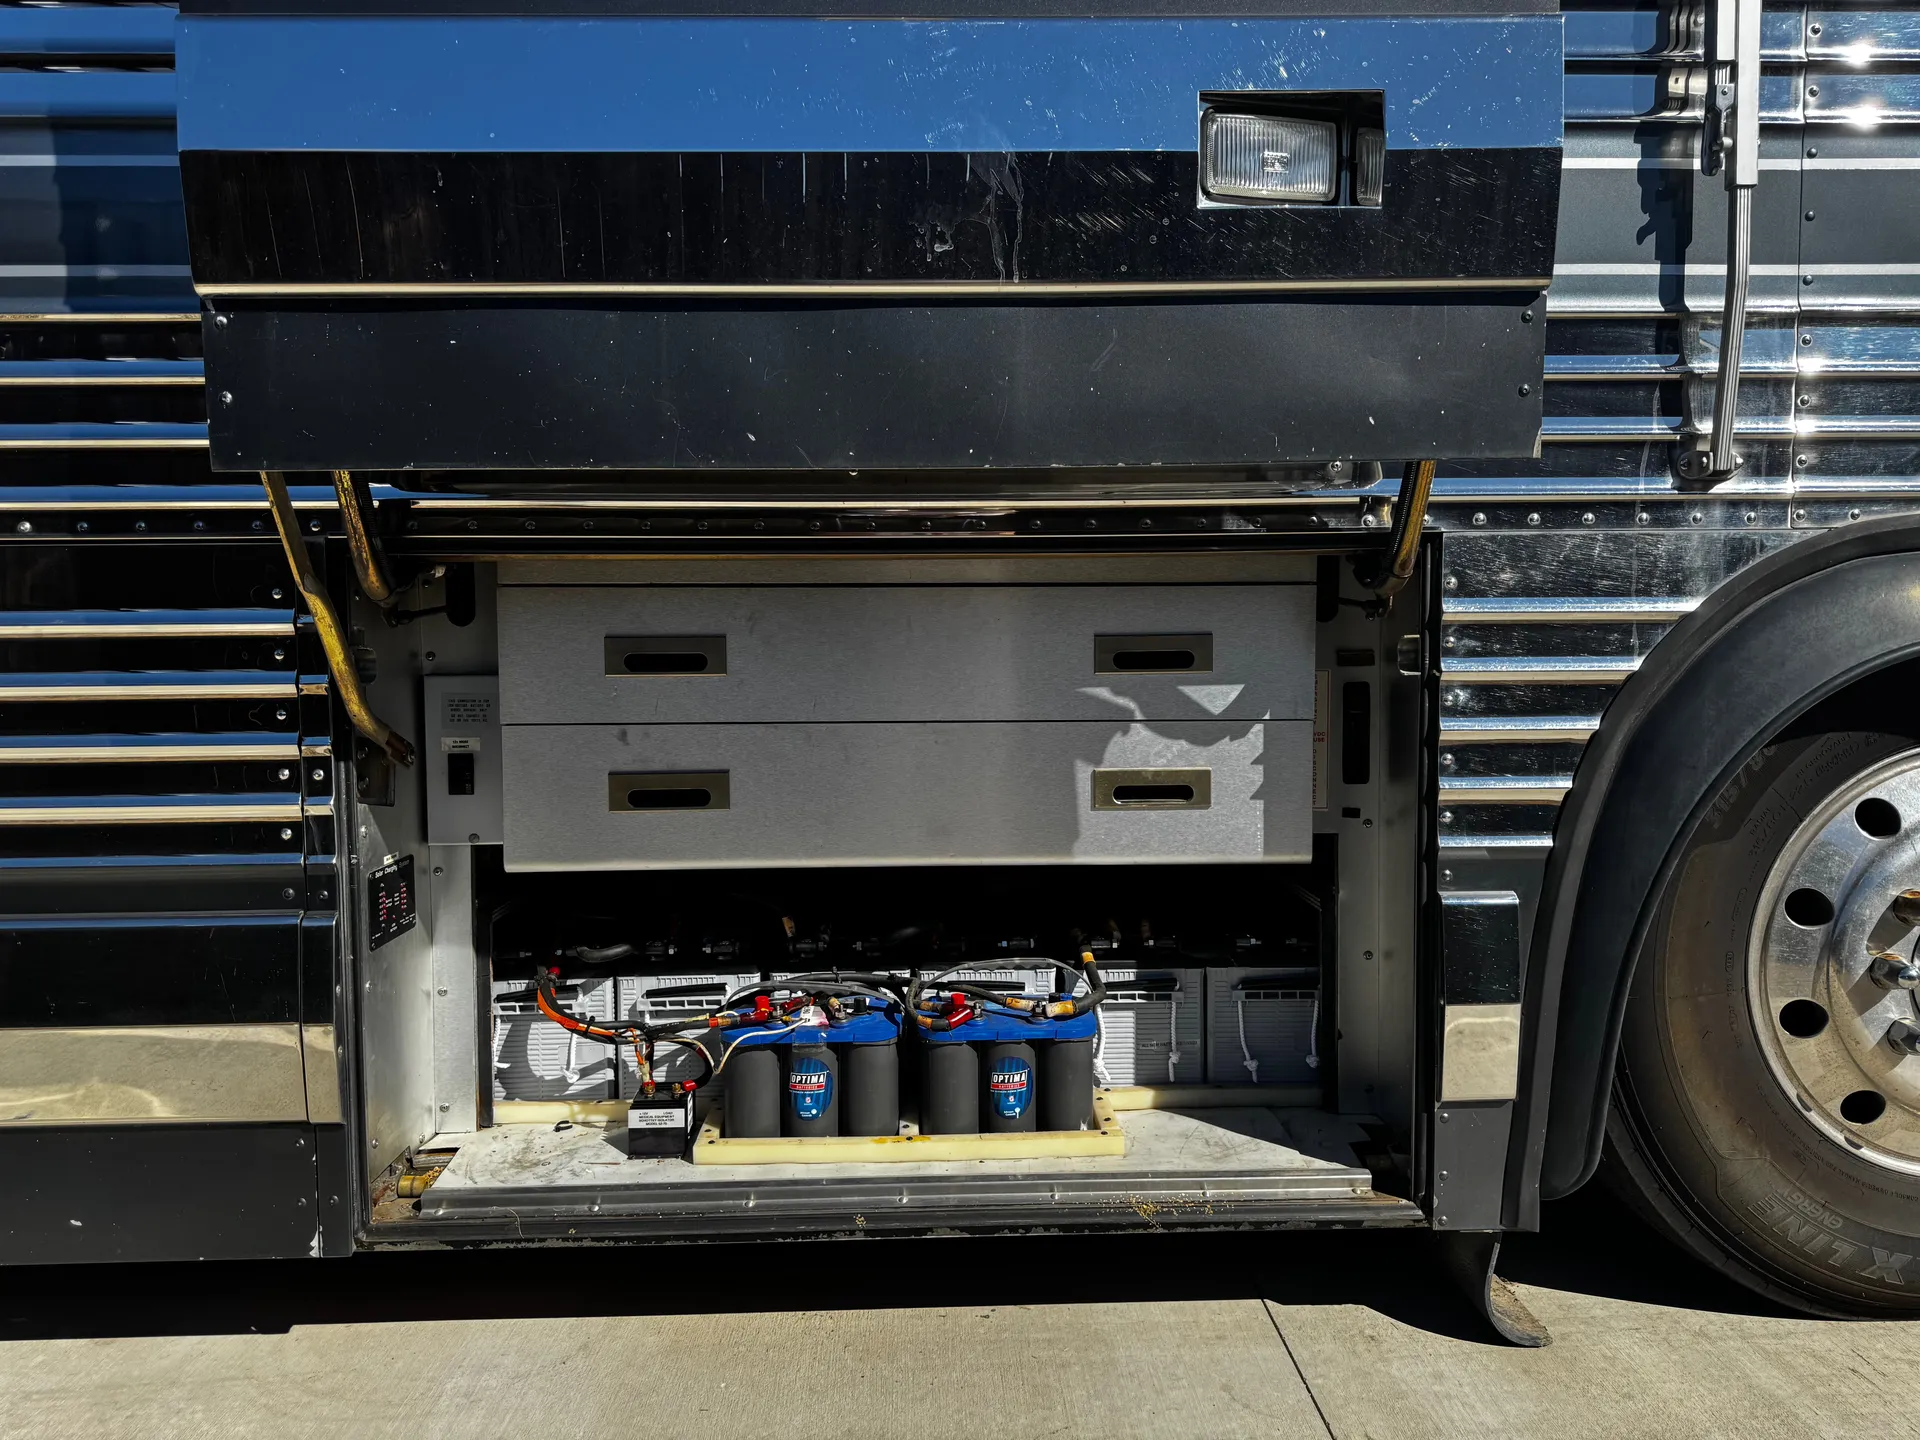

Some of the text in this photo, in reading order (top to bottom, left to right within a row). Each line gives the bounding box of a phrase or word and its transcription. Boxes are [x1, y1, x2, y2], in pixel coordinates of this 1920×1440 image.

[374, 870, 384, 879] Solar
[791, 1074, 824, 1084] OPTIMA
[993, 1072, 1026, 1083] OPTIMA
[1778, 1188, 1844, 1230] ENERGY
